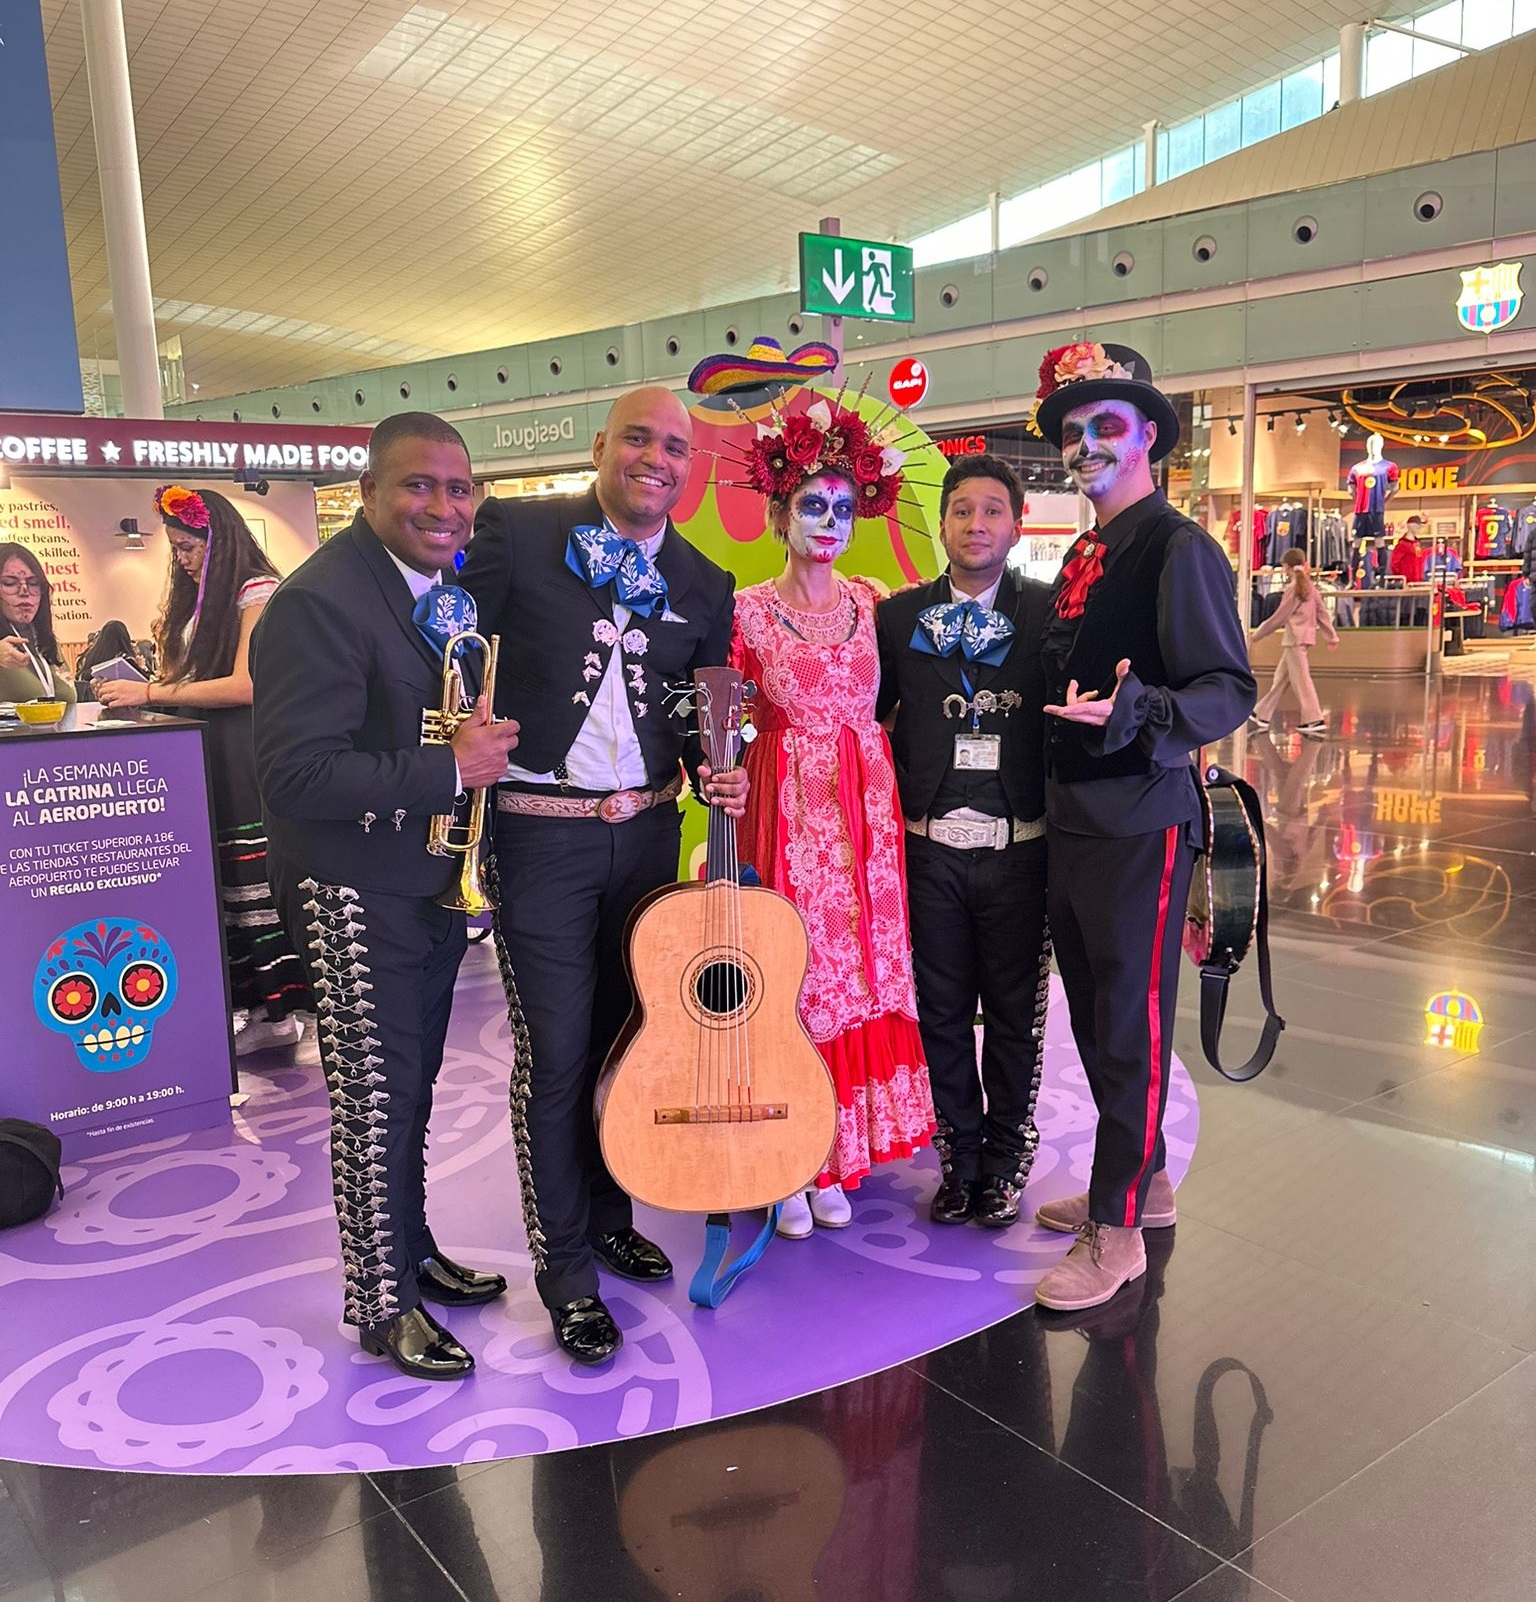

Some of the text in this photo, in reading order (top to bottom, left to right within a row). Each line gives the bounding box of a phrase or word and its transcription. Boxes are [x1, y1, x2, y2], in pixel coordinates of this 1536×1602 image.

[0, 435, 369, 467] OFFEE FRESHLY MADE FOO
[23, 515, 71, 530] smell,
[23, 759, 149, 789] ¡LA SEMANA DE
[5, 777, 168, 807] LA CATRINA LLEGA
[12, 796, 166, 827] AL AEROPUERTO!
[0, 842, 193, 875] E LAS TIENDAS Y RESTAURANTES DEL
[9, 831, 175, 860] CON TU TICKET SUPERIOR A 18€
[8, 857, 180, 888] AEROPUERTO TE PUEDES LLEVAR
[30, 886, 48, 899] UN
[49, 880, 95, 896] REGALO
[50, 1085, 185, 1122] Horario: de 9:00 h a 19:00 h.
